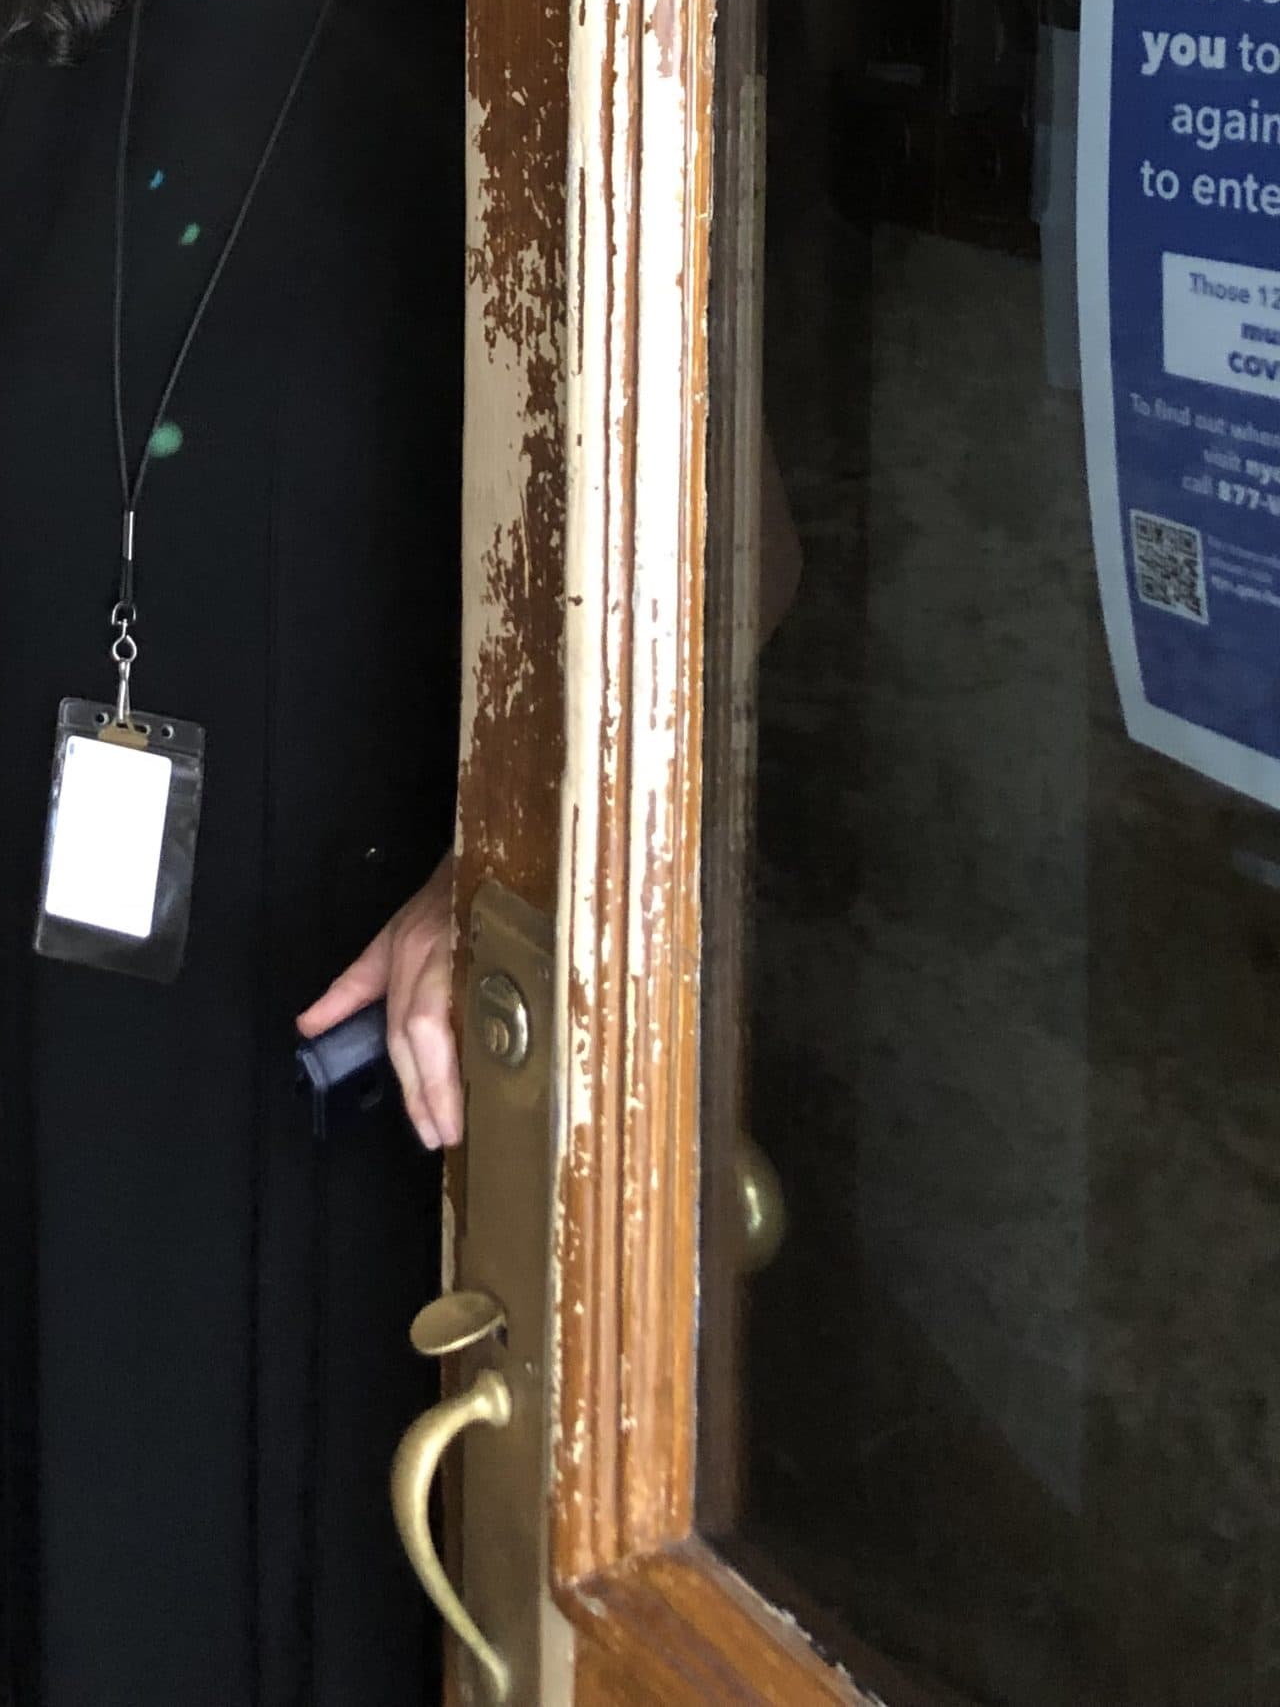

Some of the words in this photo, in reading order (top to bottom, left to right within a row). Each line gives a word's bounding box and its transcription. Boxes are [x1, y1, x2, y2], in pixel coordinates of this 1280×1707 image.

[1140, 30, 1226, 76] you
[1238, 33, 1280, 74] to
[1140, 160, 1180, 200] to
[1189, 272, 1250, 304] Those
